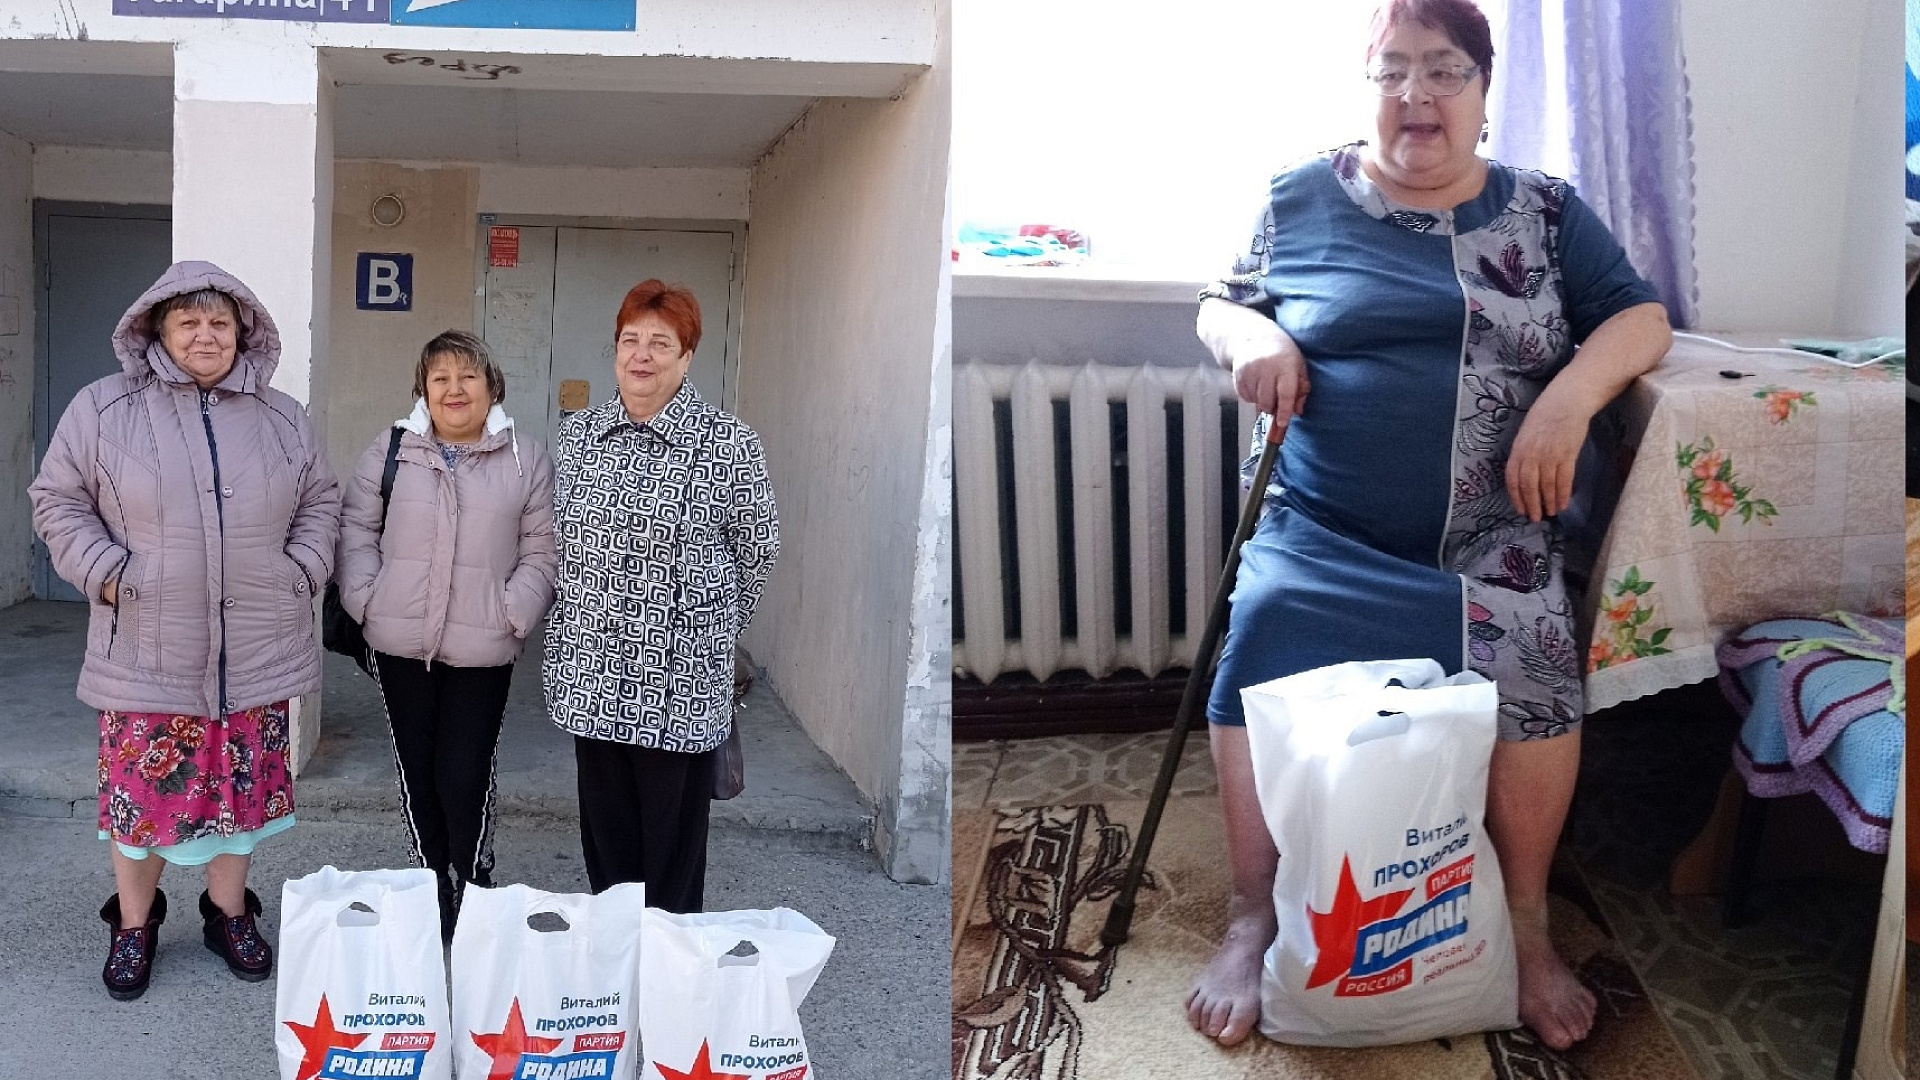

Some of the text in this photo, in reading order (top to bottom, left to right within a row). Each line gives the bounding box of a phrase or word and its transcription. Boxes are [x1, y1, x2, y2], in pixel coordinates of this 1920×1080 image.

[1373, 833, 1470, 888] ПРОХОРОВ
[1345, 968, 1407, 993] РОССИЯ
[560, 991, 621, 1010] Виталий
[343, 1012, 426, 1028] ПРОХОРОВ
[535, 1013, 619, 1032] ПРОХОРОВ
[386, 1035, 431, 1047] ПАРТИЯ
[579, 1034, 620, 1048] ПАРТИЯ
[328, 1055, 416, 1077] РОДИНА
[520, 1058, 608, 1080] РОДИНА
[720, 1051, 804, 1070] ПРОХОРОВ
